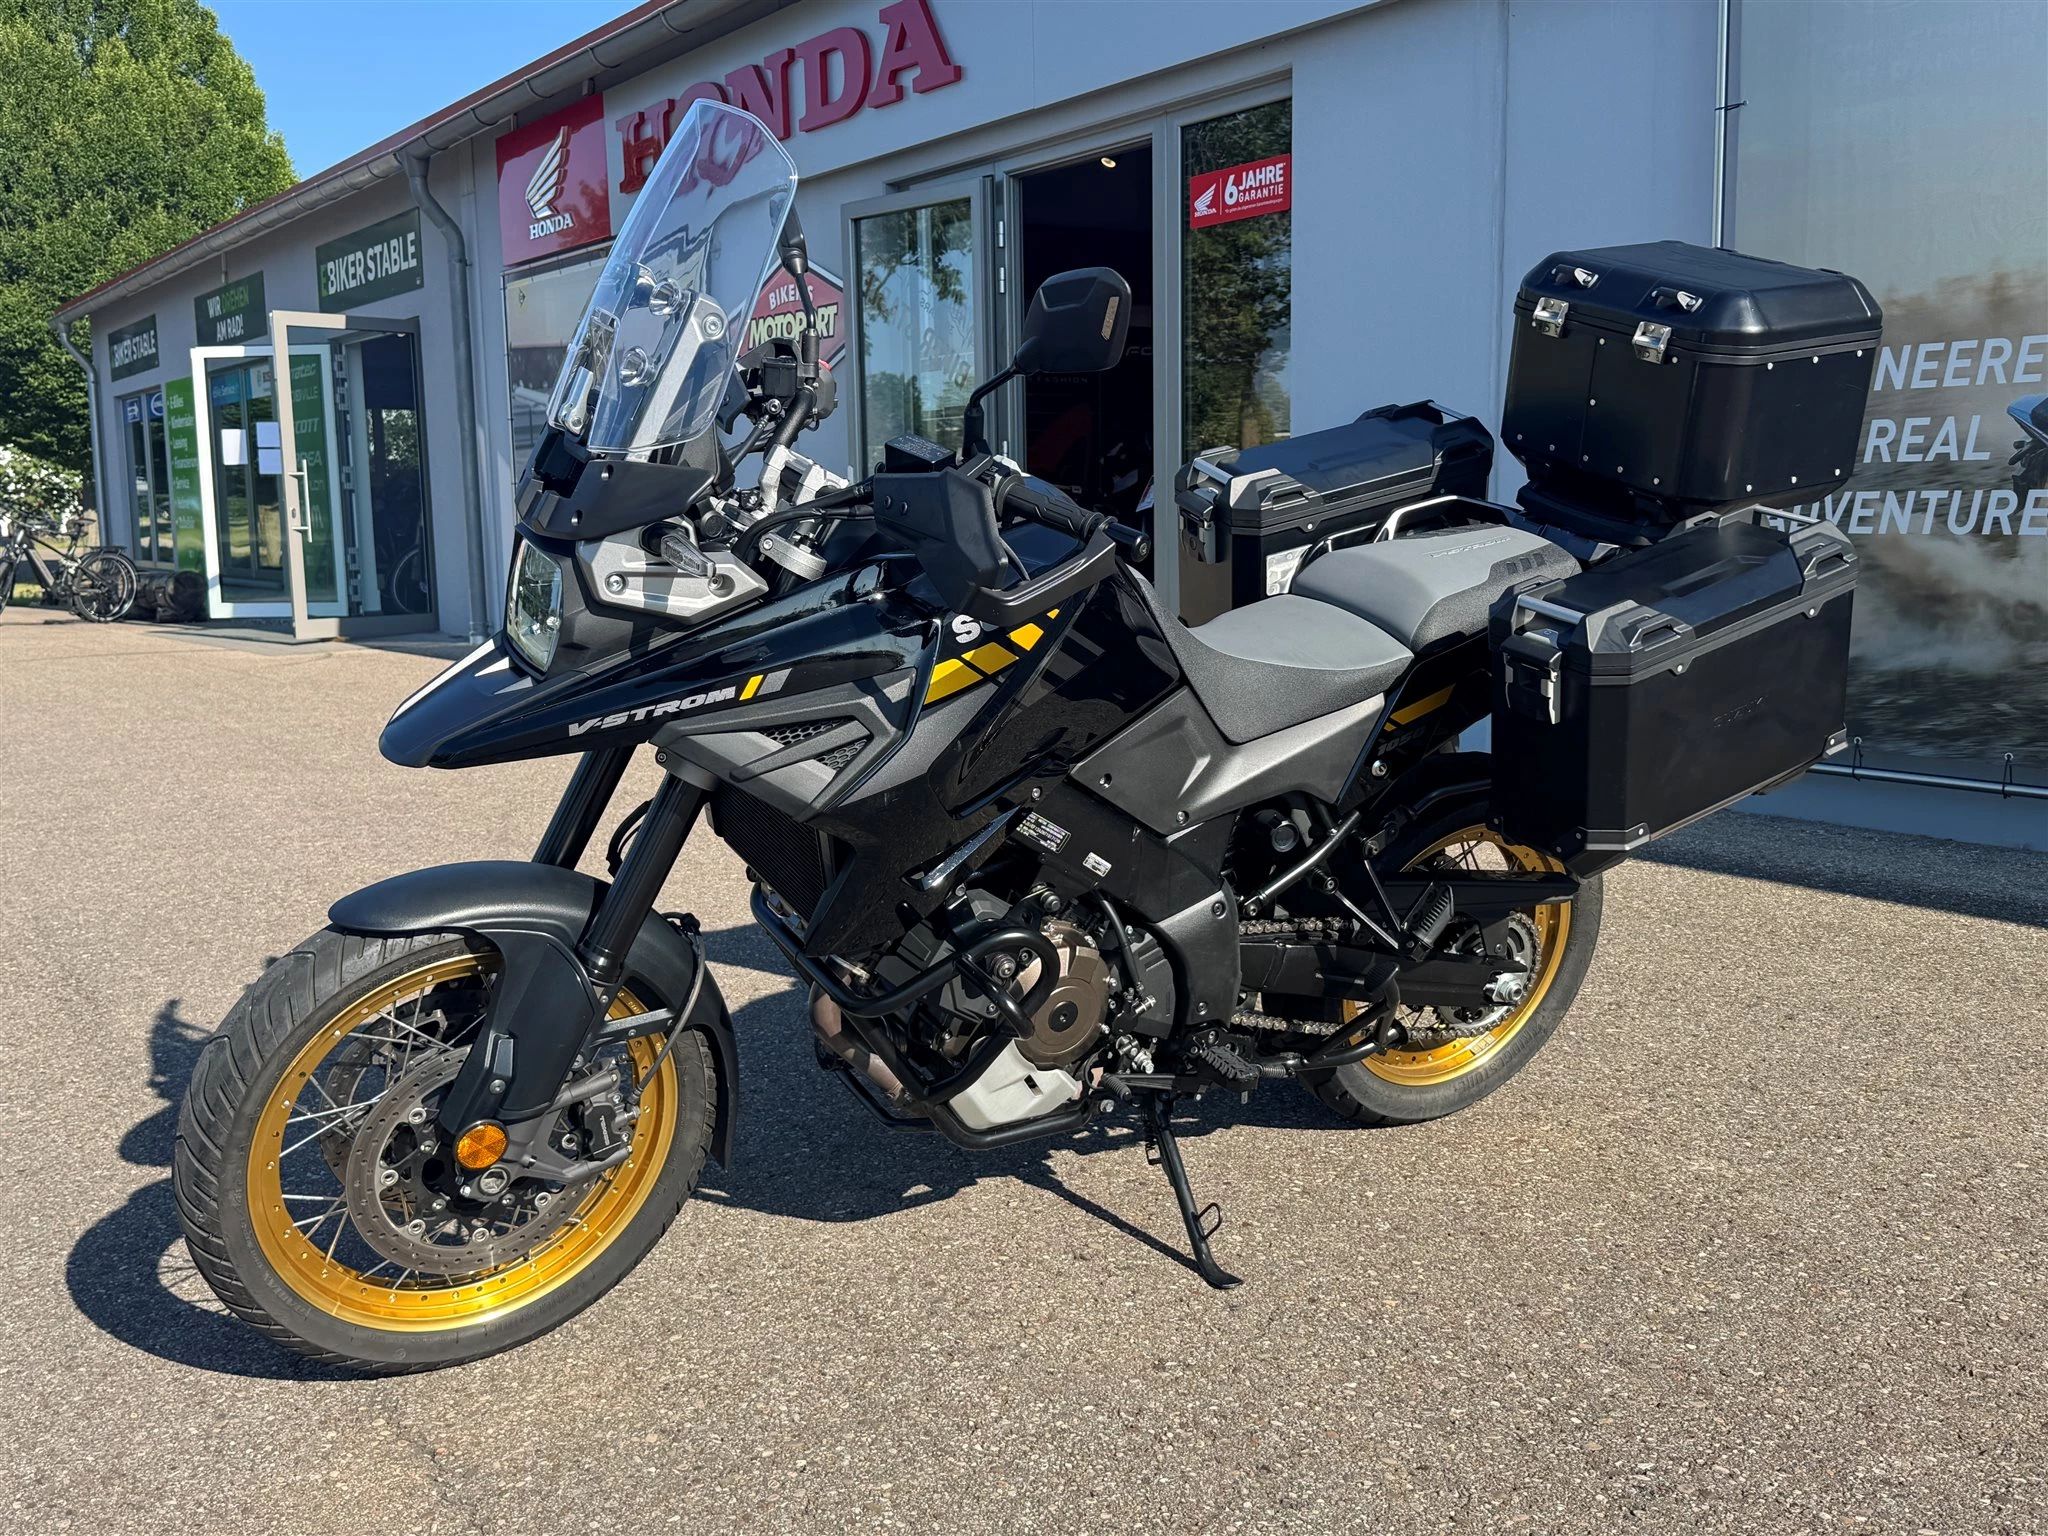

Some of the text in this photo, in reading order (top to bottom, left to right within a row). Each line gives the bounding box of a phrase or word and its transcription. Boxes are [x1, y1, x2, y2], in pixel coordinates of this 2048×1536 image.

[616, 0, 962, 194] HONDA
[1224, 162, 1284, 205] 6 JAHRE
[1239, 183, 1284, 203] GARANTIE
[529, 212, 574, 240] HONDA
[1194, 207, 1217, 218] HONDA
[367, 231, 417, 281] STABLE
[207, 295, 222, 319] WIR
[768, 284, 814, 310] BIKES
[217, 313, 244, 343] AM RAD!
[749, 302, 838, 348] MOTOPRT
[132, 330, 156, 361] STABLE
[1863, 414, 1992, 464] REAL
[568, 686, 737, 737] V-STROM
